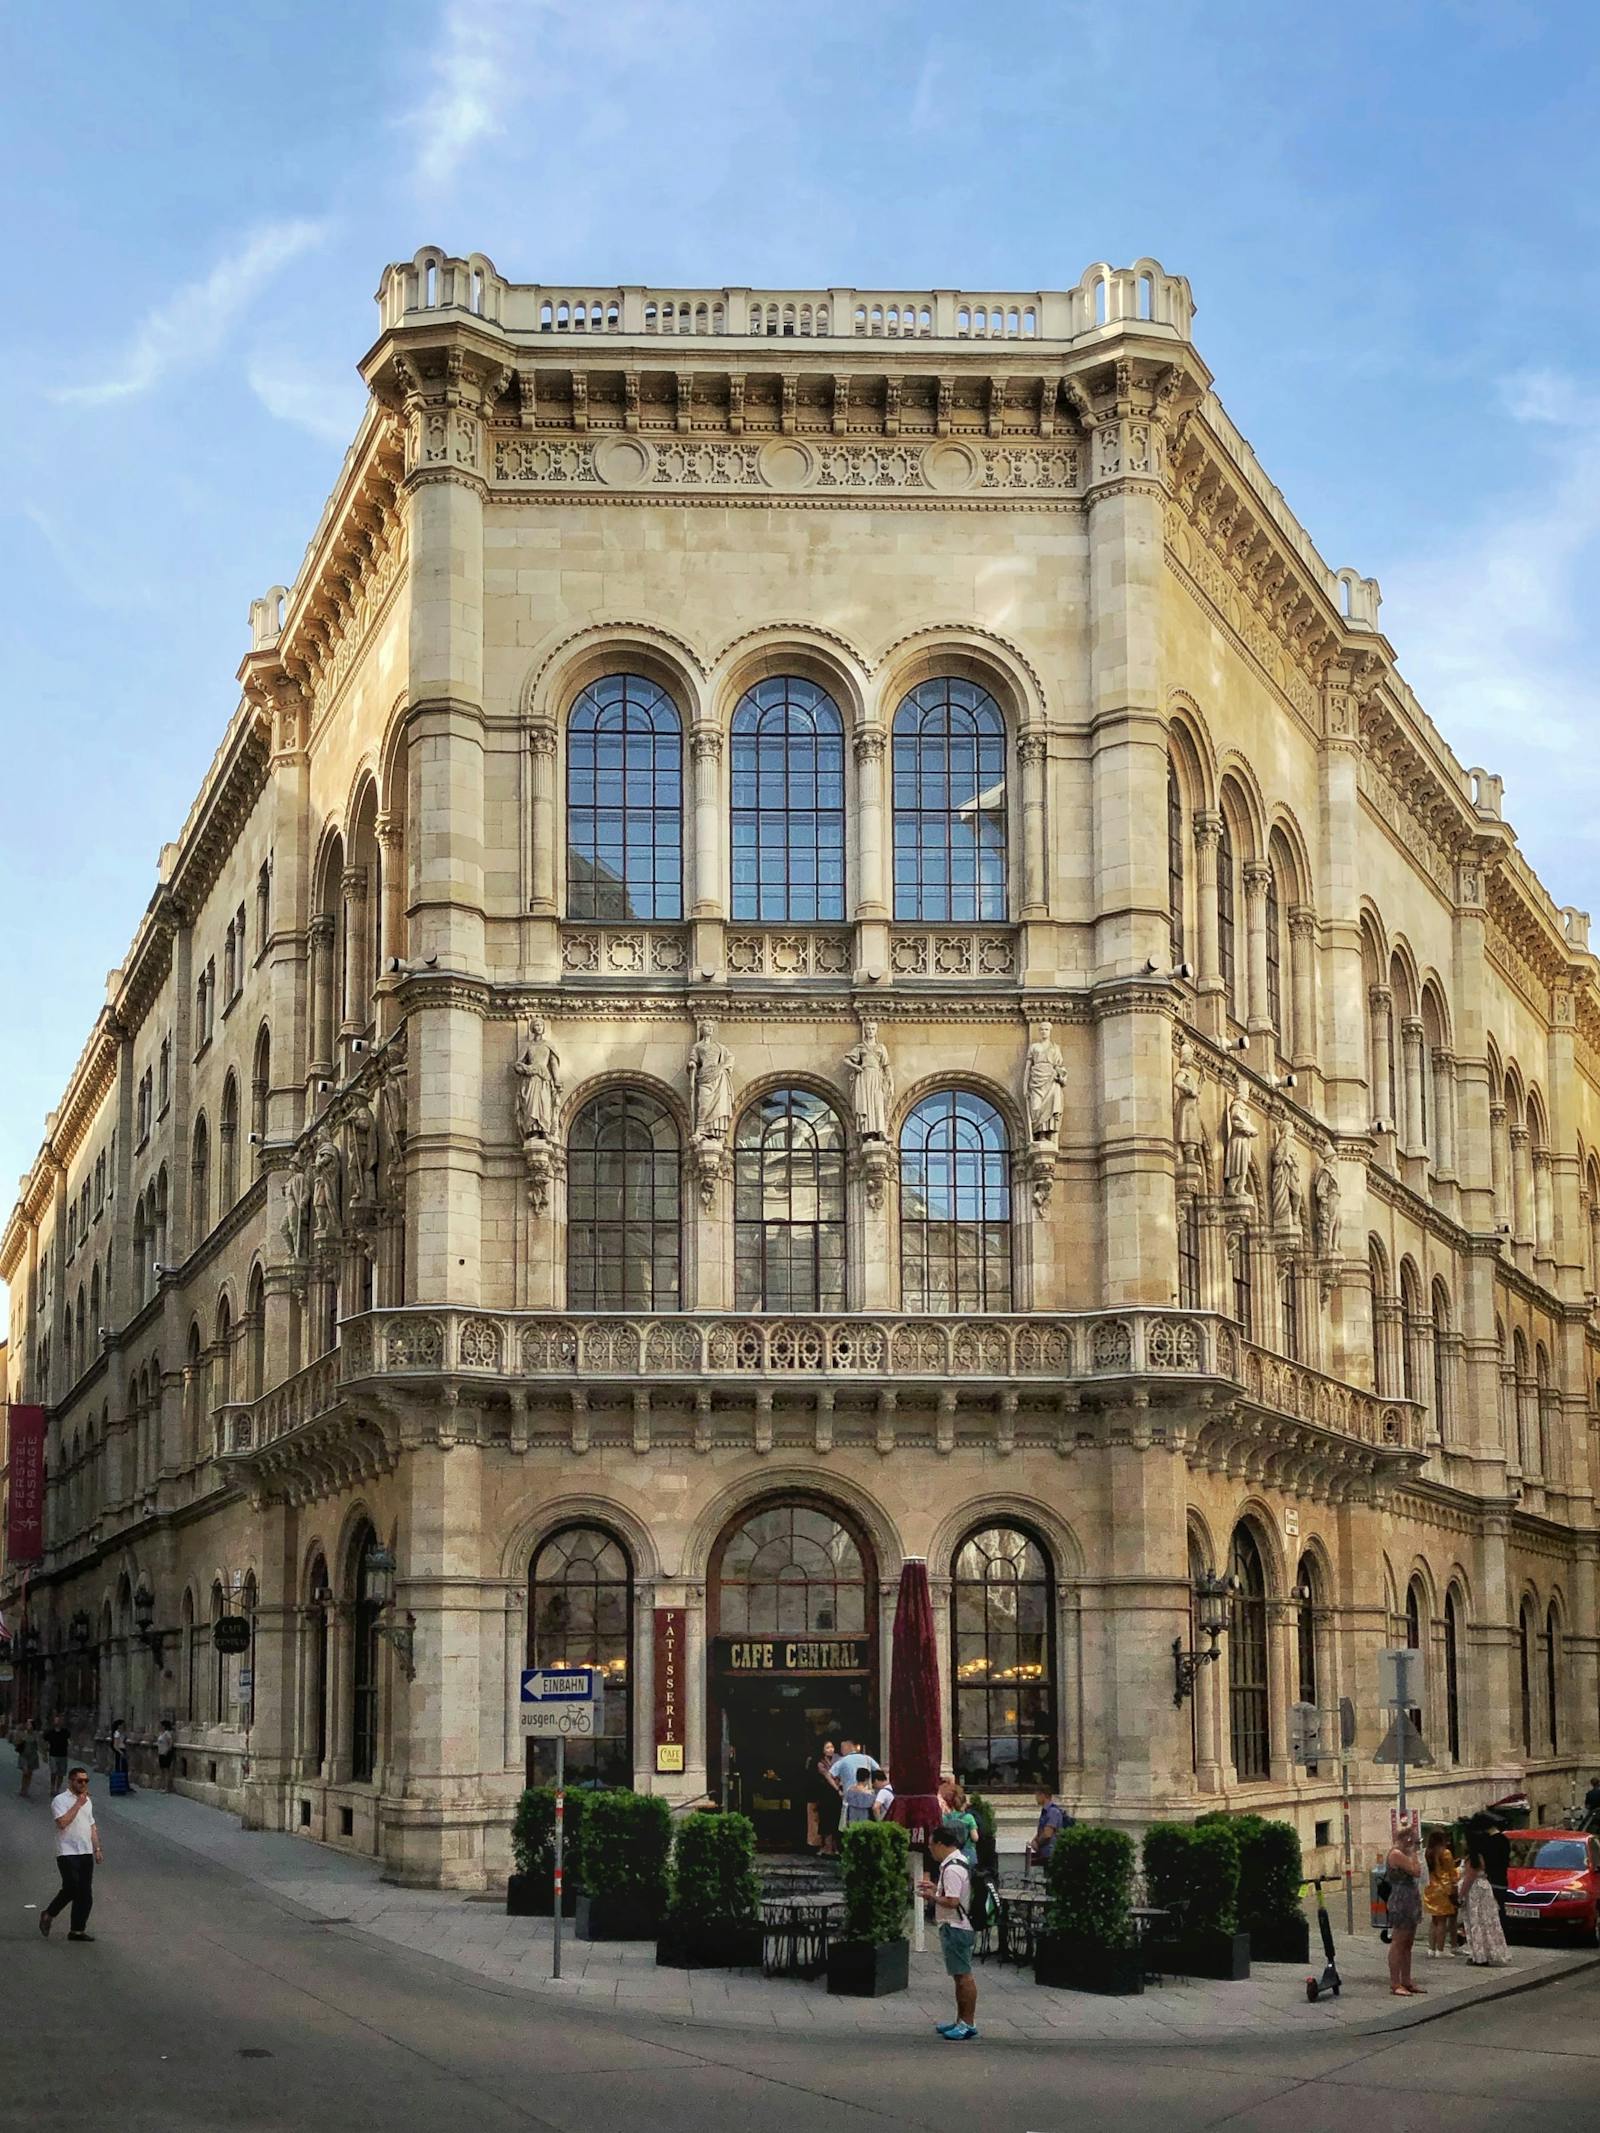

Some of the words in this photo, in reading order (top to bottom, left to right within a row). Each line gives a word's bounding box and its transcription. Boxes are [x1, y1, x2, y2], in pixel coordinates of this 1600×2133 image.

[16, 1436, 26, 1508] FERSTEL
[27, 1436, 37, 1508] PASSAGE
[665, 1612, 675, 1742] PATISSERIE
[731, 1643, 774, 1668] CAFE
[785, 1643, 859, 1668] CENTRAL
[543, 1678, 585, 1692] EINBAHN
[521, 1713, 558, 1728] ausgen.
